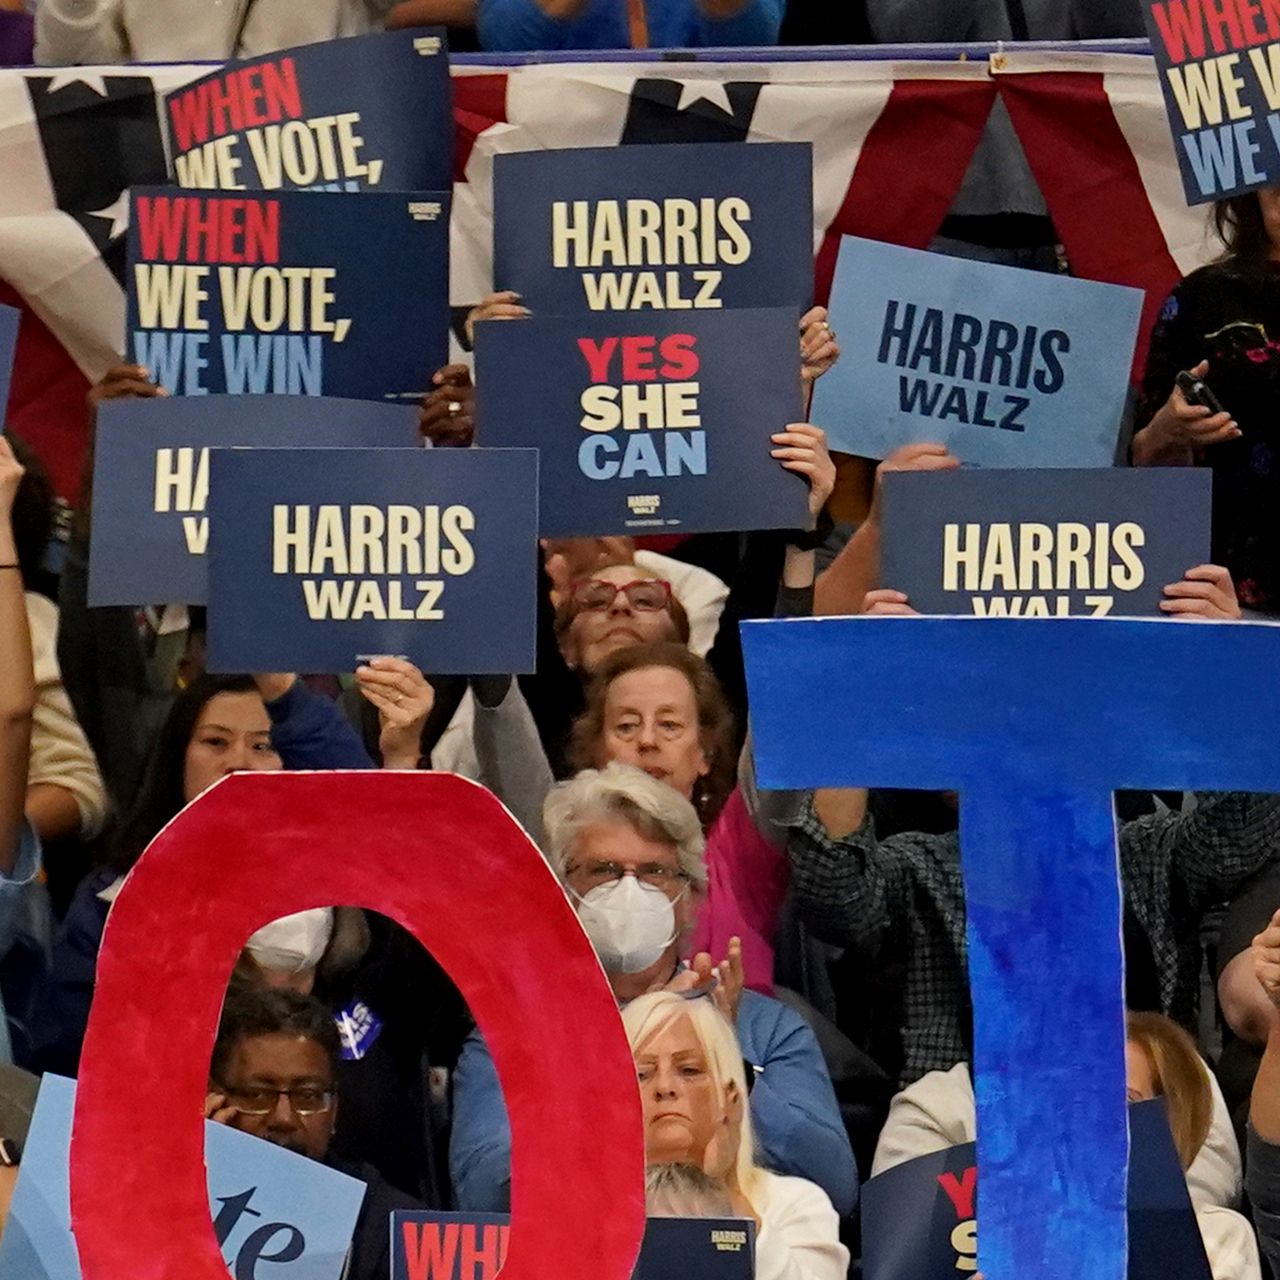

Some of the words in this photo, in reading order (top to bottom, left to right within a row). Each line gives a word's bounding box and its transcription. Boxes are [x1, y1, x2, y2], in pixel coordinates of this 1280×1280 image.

[169, 57, 302, 151] WHEN
[1167, 57, 1245, 129] WE
[176, 136, 246, 189] WE
[249, 112, 384, 190] VOTE,
[1180, 116, 1267, 195] WE
[136, 196, 281, 263] WHEN
[552, 197, 751, 269] HARRIS
[135, 263, 209, 330] WE
[219, 267, 352, 343] VOTE,
[582, 270, 721, 311] WALZ
[134, 333, 208, 396] WE
[221, 334, 321, 397] WIN
[579, 333, 699, 383] YES
[877, 300, 1071, 394] HARRIS
[580, 382, 700, 432] SHE
[898, 375, 1030, 433] WALZ
[579, 431, 708, 480] CAN
[272, 505, 474, 575] HARRIS
[942, 522, 1145, 592] HARRIS
[302, 581, 445, 621] WALZ
